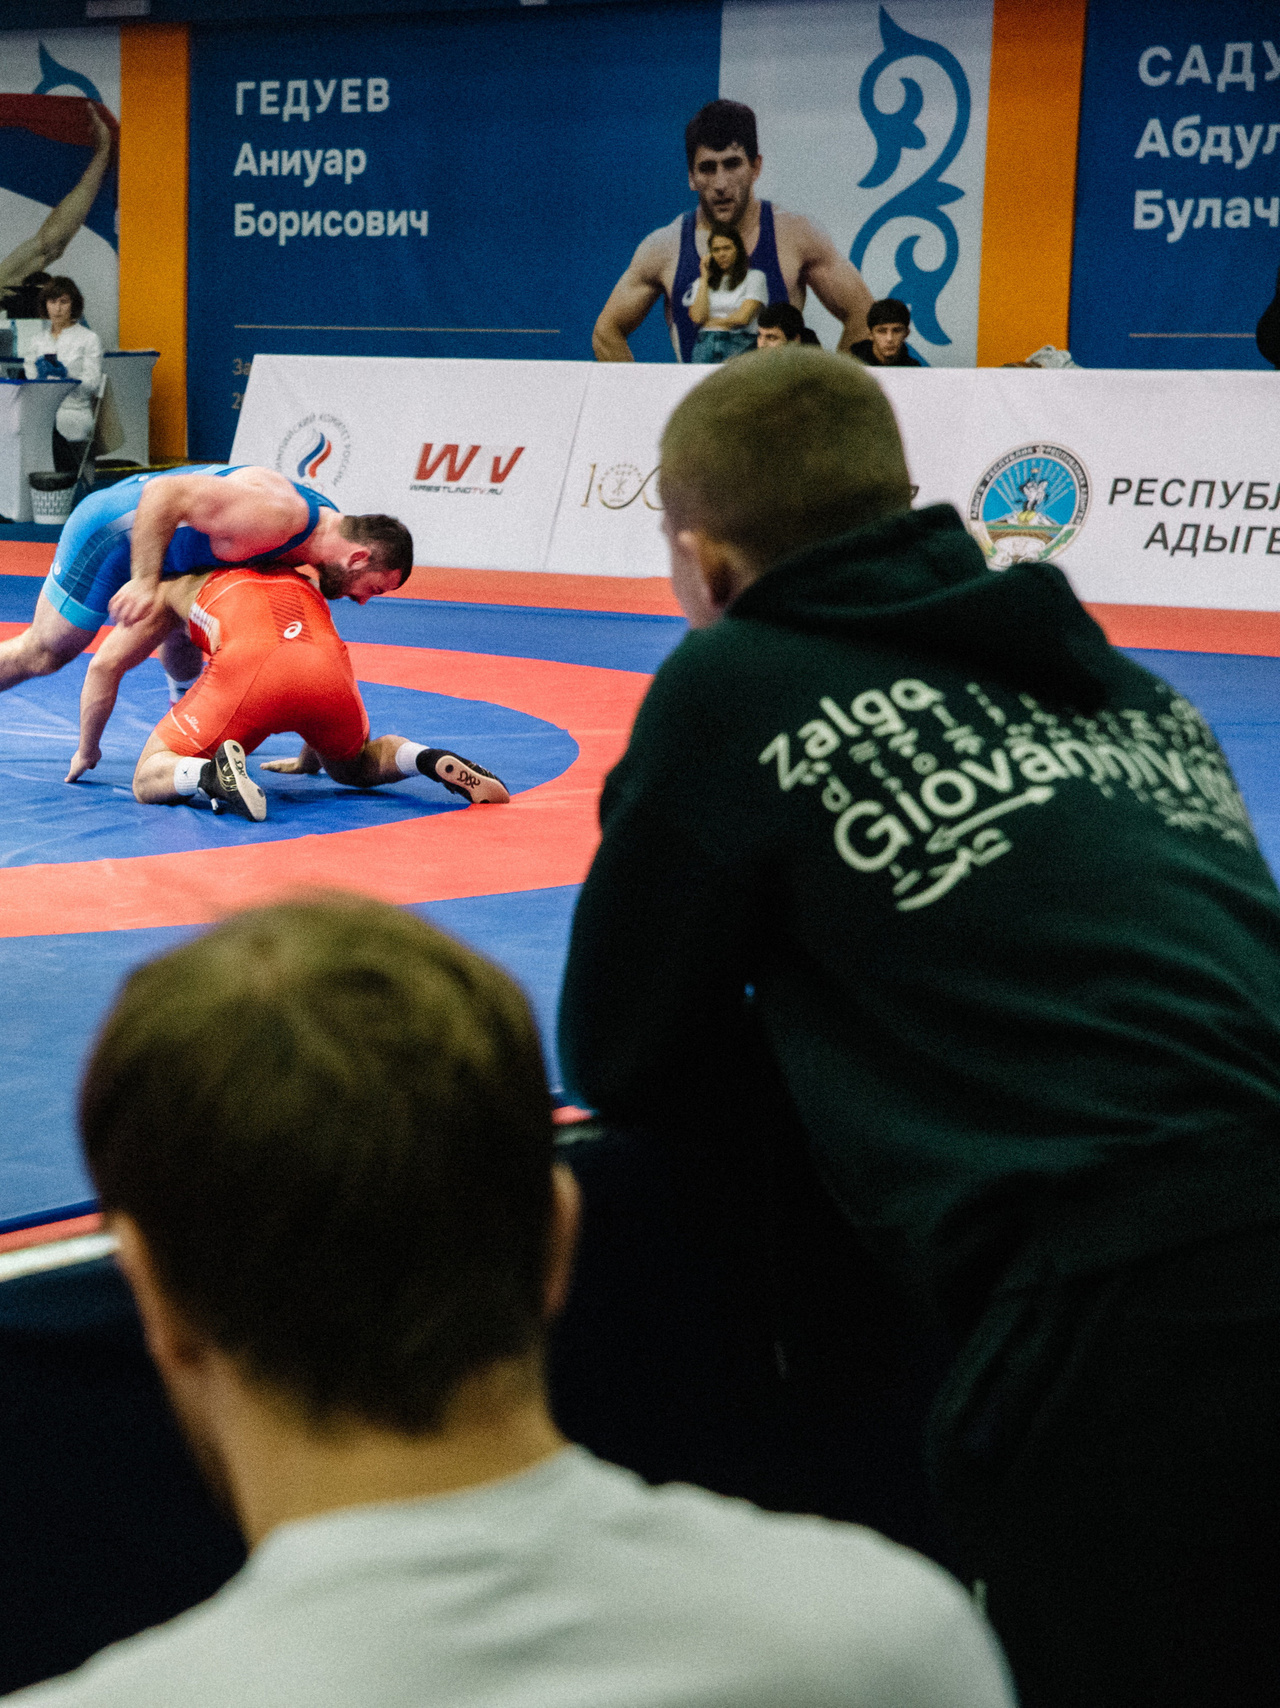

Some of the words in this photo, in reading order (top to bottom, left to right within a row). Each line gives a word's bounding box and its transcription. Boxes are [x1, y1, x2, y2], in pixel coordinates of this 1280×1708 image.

[235, 77, 390, 122] ГЕДУЕВ
[233, 142, 367, 187] Аниуар
[234, 203, 428, 246] Борисович
[1133, 189, 1280, 243] Булач
